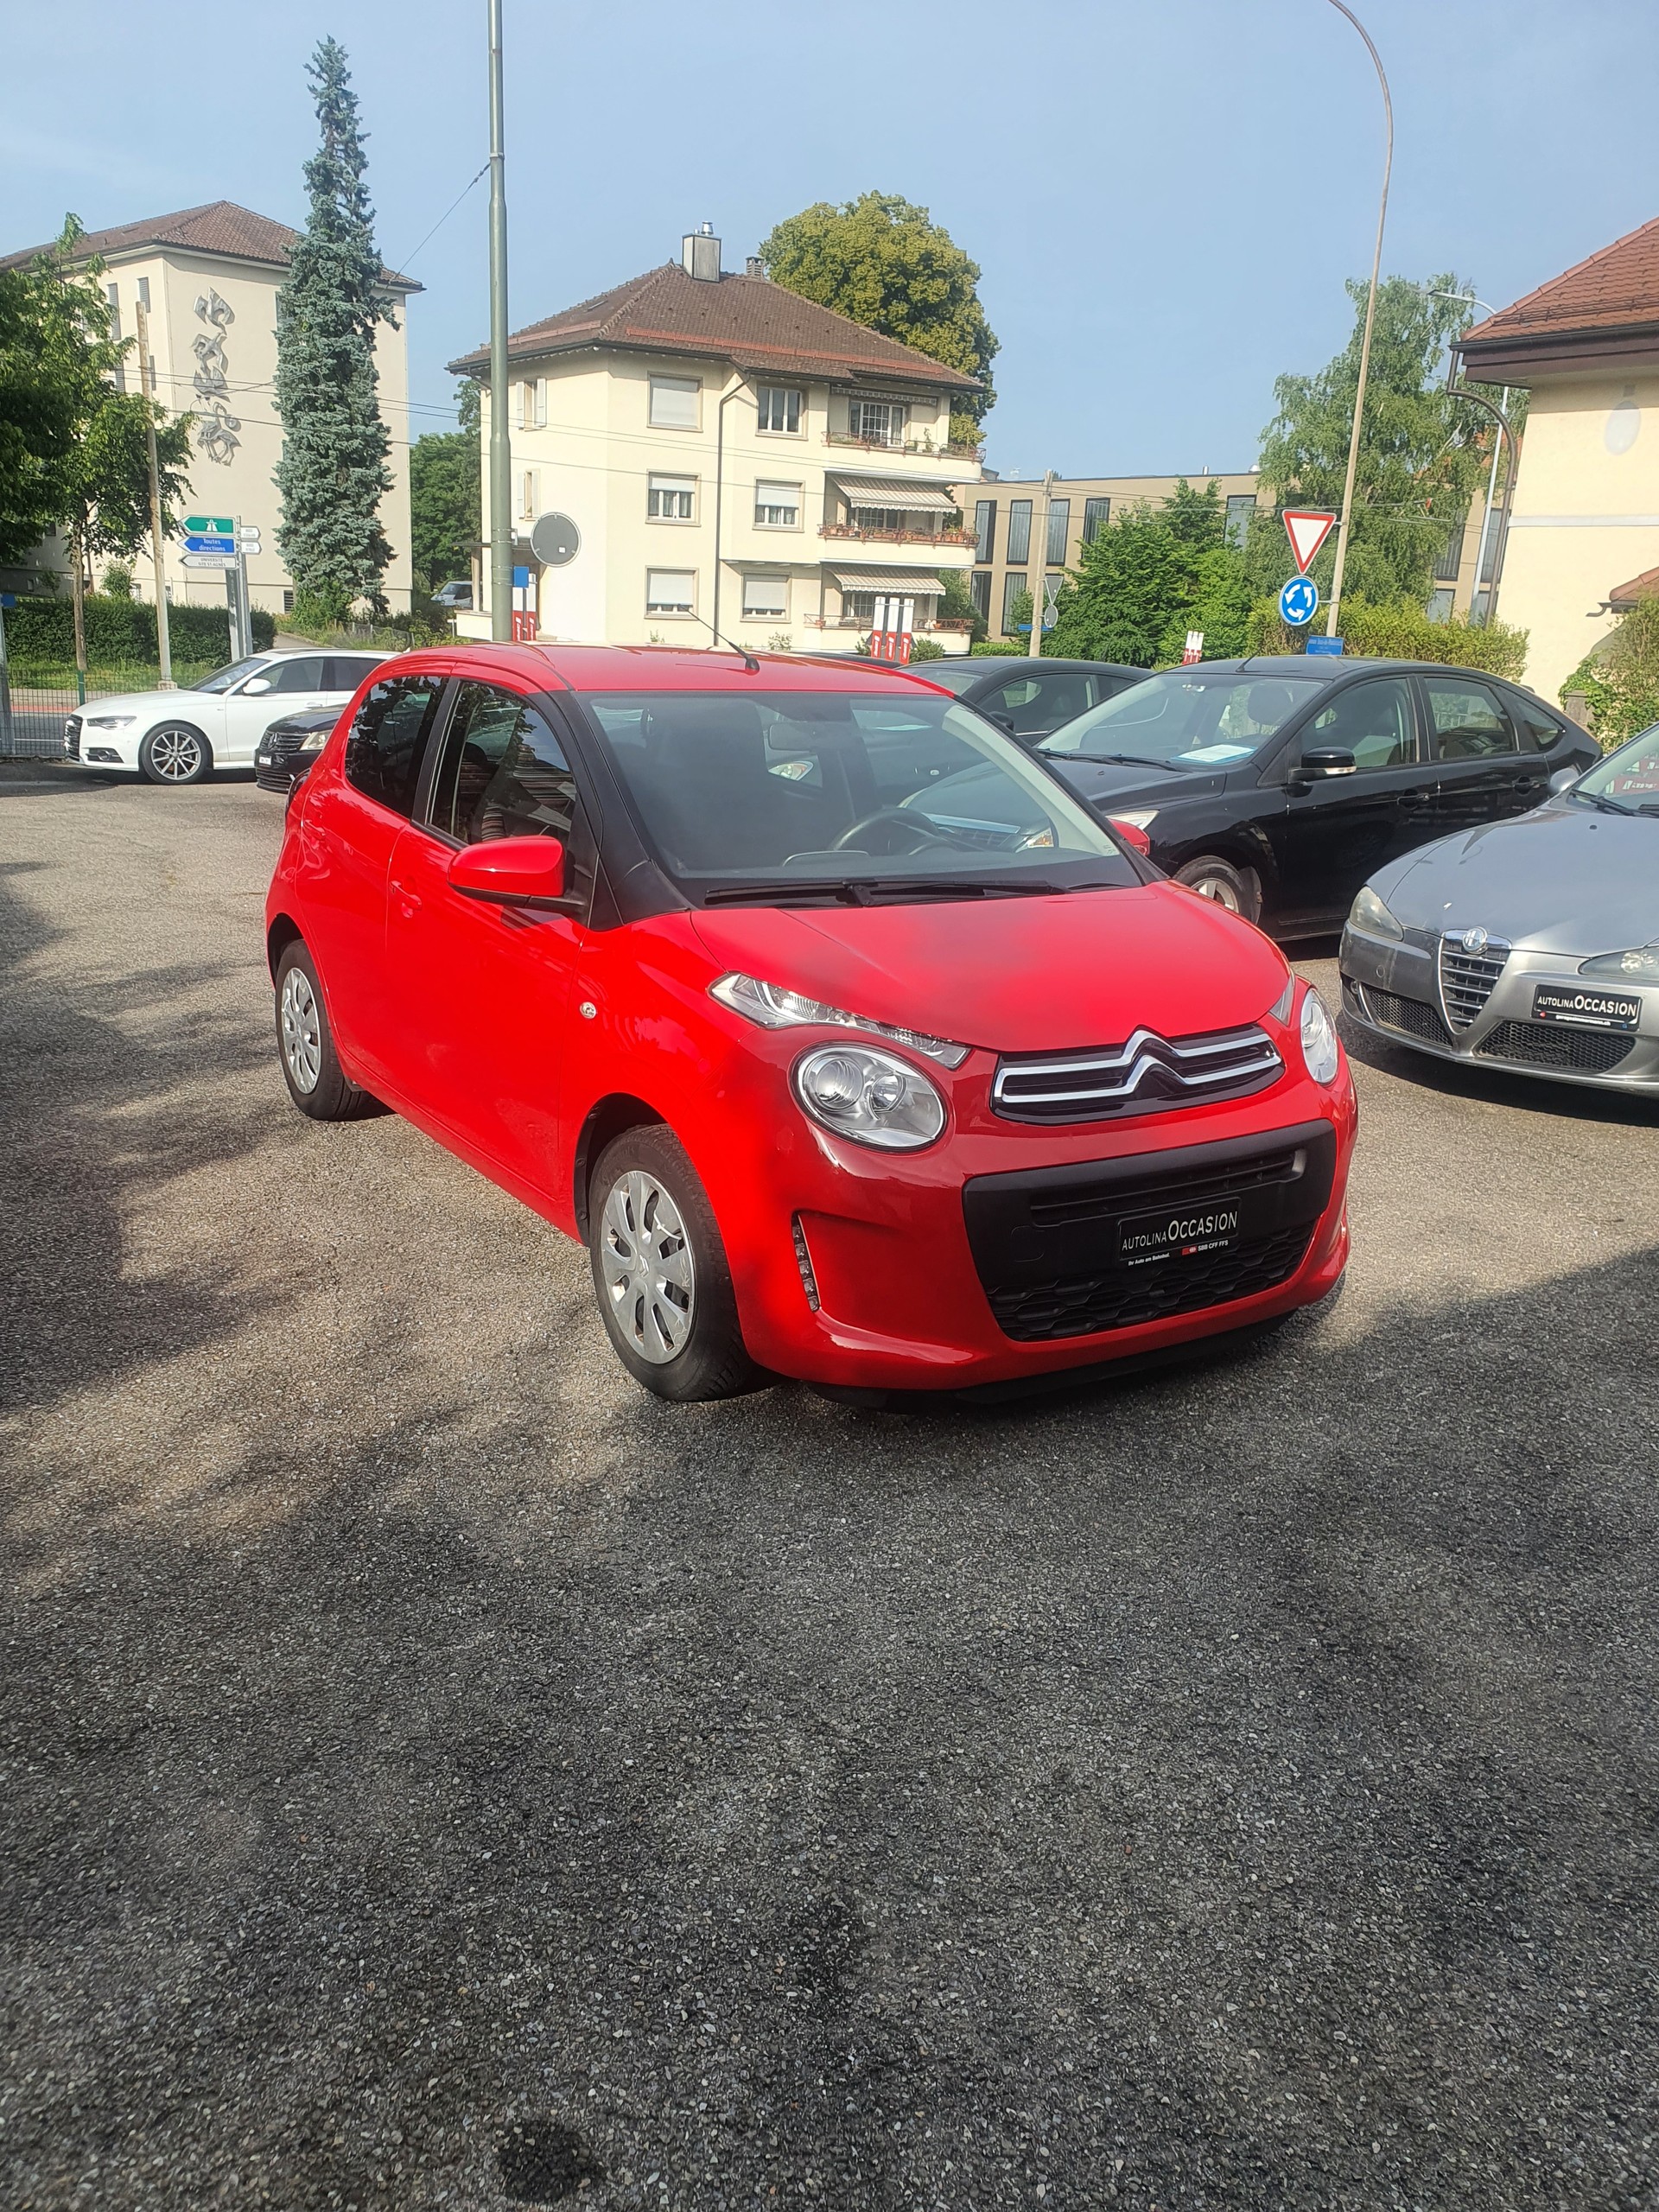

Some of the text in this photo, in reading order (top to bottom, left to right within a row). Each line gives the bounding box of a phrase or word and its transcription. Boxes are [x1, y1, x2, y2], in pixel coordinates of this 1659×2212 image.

[1538, 995, 1637, 1017] AUTOLINA OCCASION
[1122, 1211, 1237, 1250] AUTOLINA OCCASION
